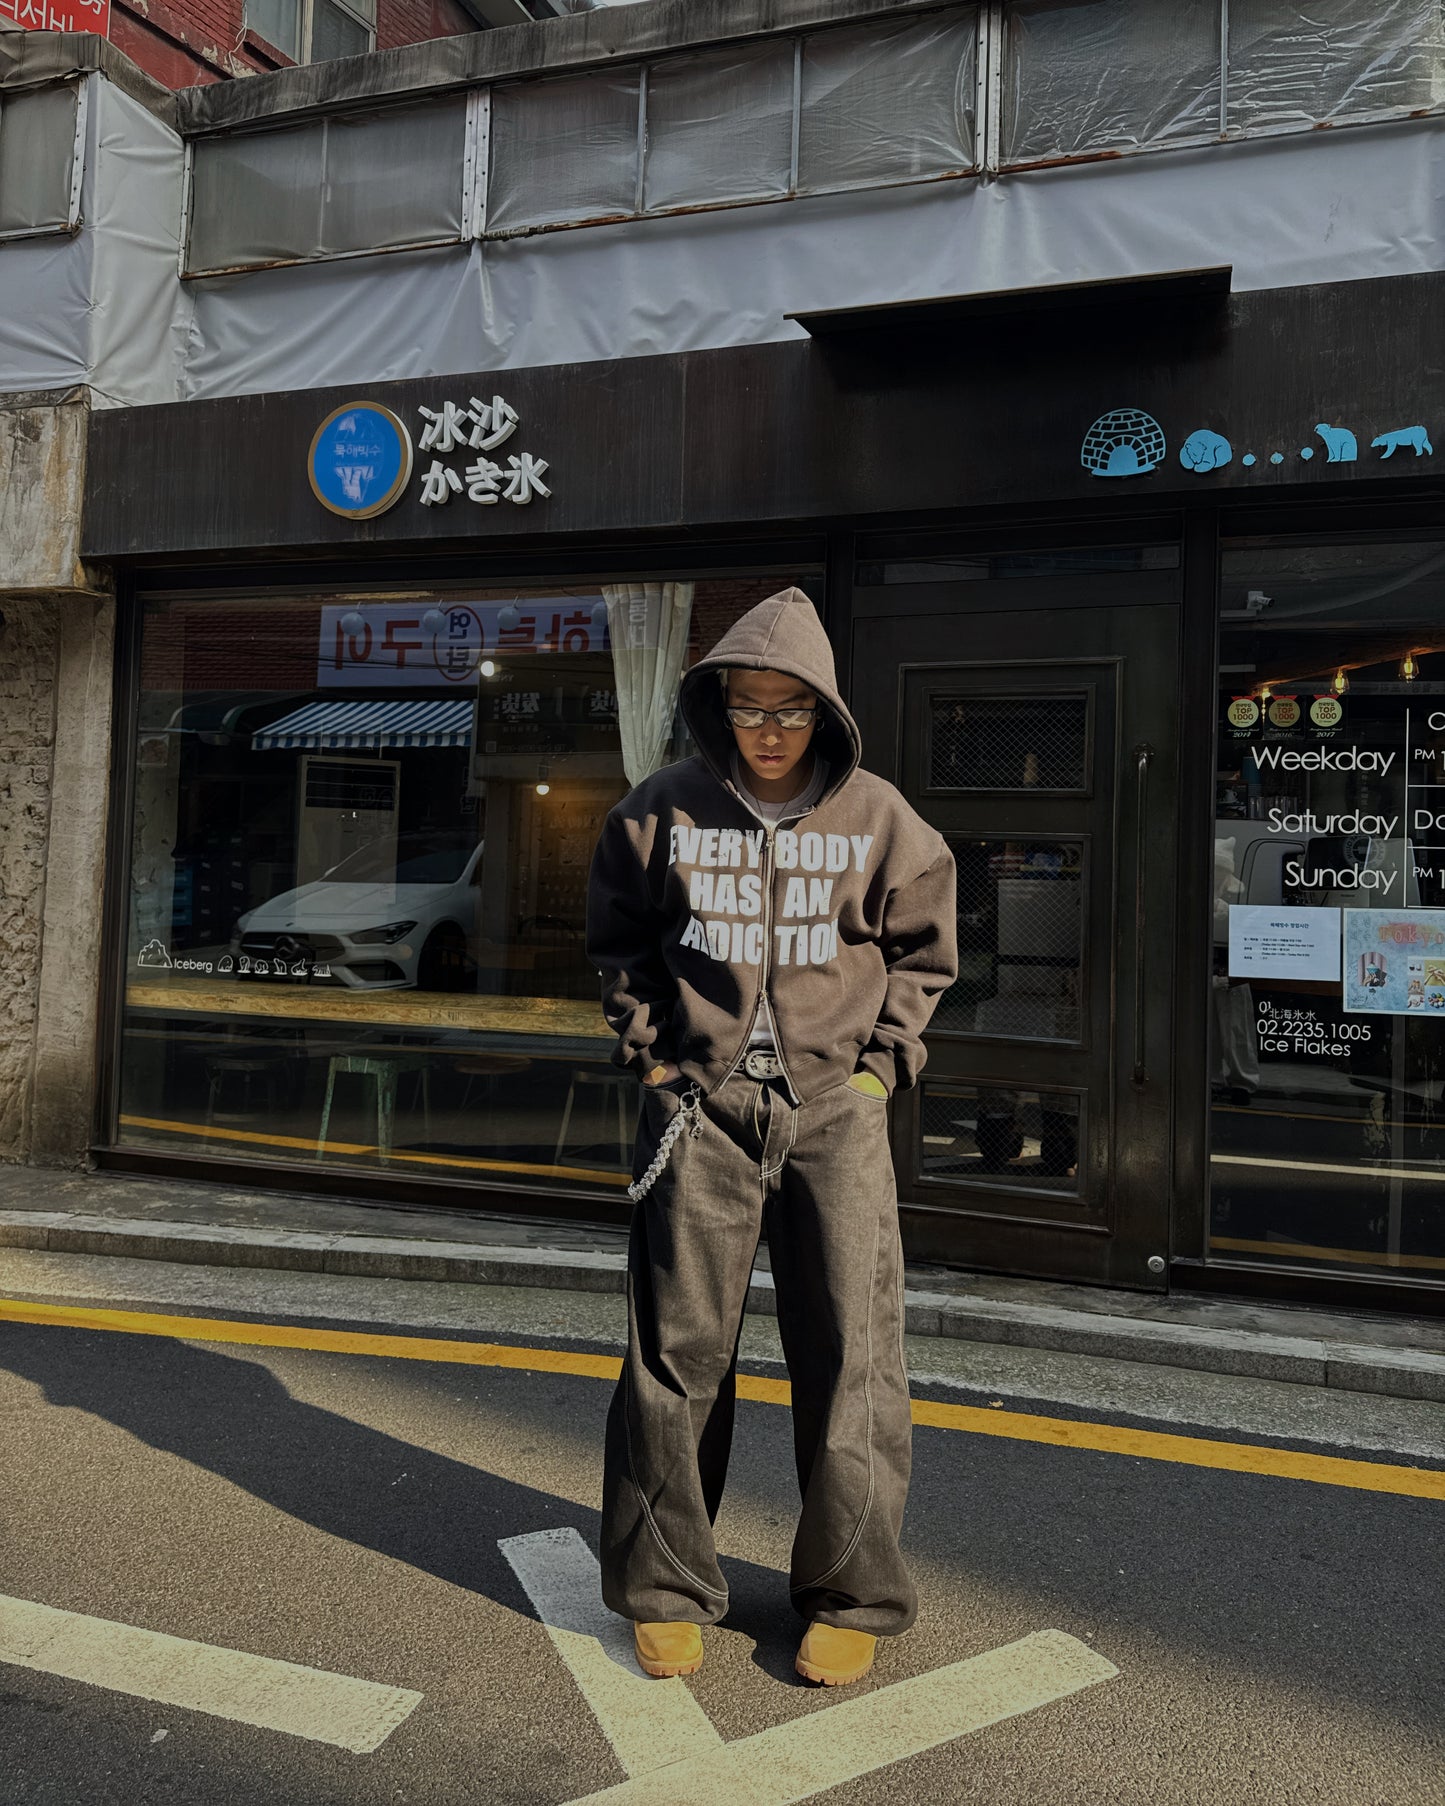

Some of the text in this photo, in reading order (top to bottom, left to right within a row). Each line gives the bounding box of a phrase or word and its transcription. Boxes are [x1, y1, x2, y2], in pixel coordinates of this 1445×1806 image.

[418, 395, 520, 453] 冰沙
[419, 452, 552, 507] かき氷
[1316, 712, 1337, 720] 1000
[1251, 745, 1396, 776] Weekday
[1414, 749, 1436, 760] PM
[1266, 808, 1399, 840] Saturday
[668, 824, 874, 873] EVERY BODY
[690, 870, 834, 918] HAS AN
[1284, 861, 1398, 895] Sunday
[1412, 866, 1434, 878] PM
[174, 958, 213, 973] Iceberg
[1256, 1019, 1372, 1041] 02.2235.1005
[1259, 1036, 1351, 1057] Ice Flakes
